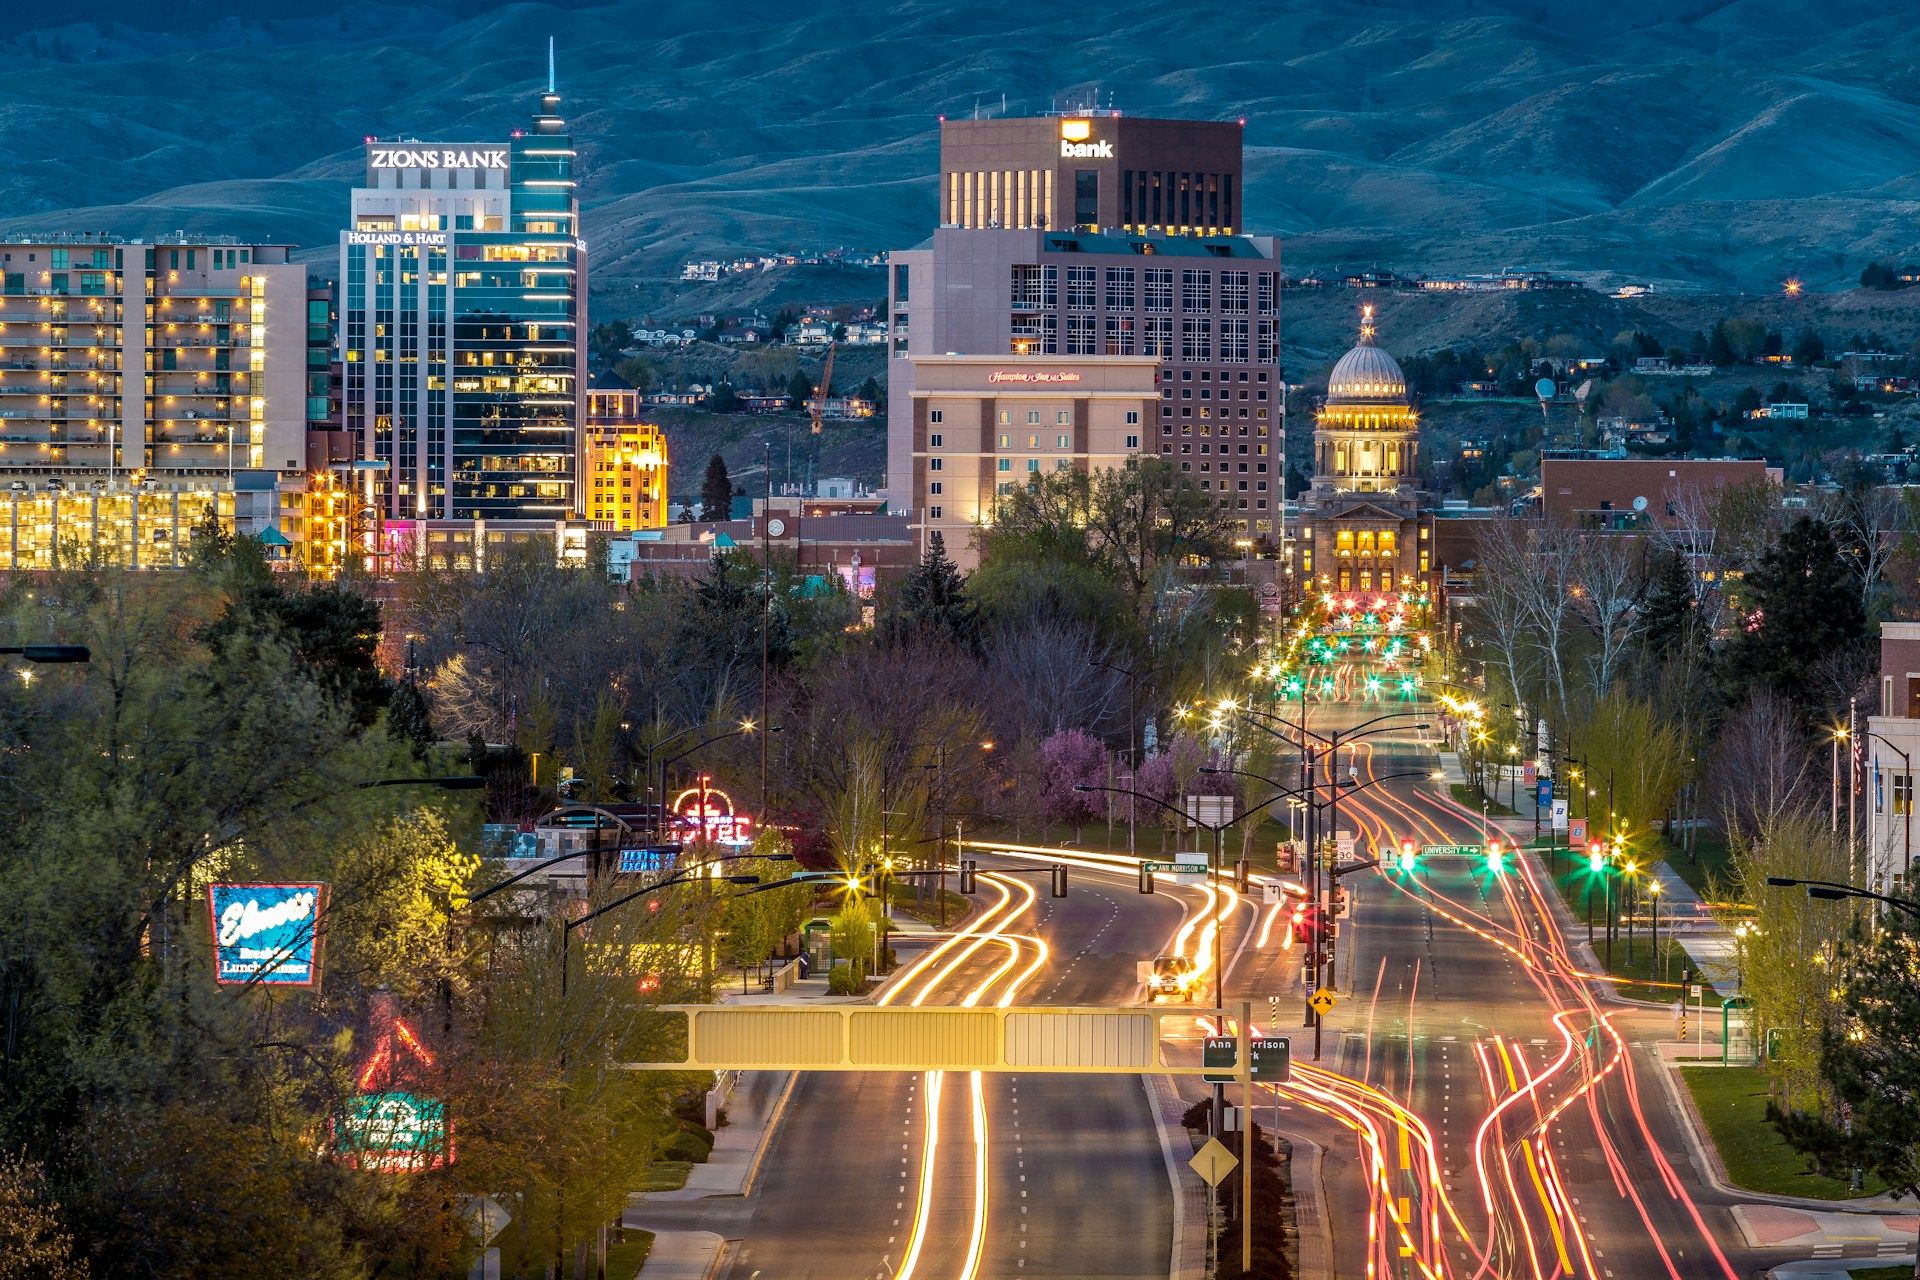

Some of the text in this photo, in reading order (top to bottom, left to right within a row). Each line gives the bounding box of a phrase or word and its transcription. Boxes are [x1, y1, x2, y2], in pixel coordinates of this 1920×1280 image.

[1061, 140, 1113, 157] bank
[371, 149, 508, 168] ZIONS BANK
[348, 232, 446, 244] HOLLAND & HART
[988, 371, 1029, 383] Hampton
[1057, 372, 1080, 381] Suites
[1556, 807, 1565, 815] B
[1339, 851, 1352, 859] 30
[1425, 846, 1460, 855] UNIVERSITY
[1171, 865, 1199, 873] MORRISON
[1208, 1039, 1232, 1049] Ann
